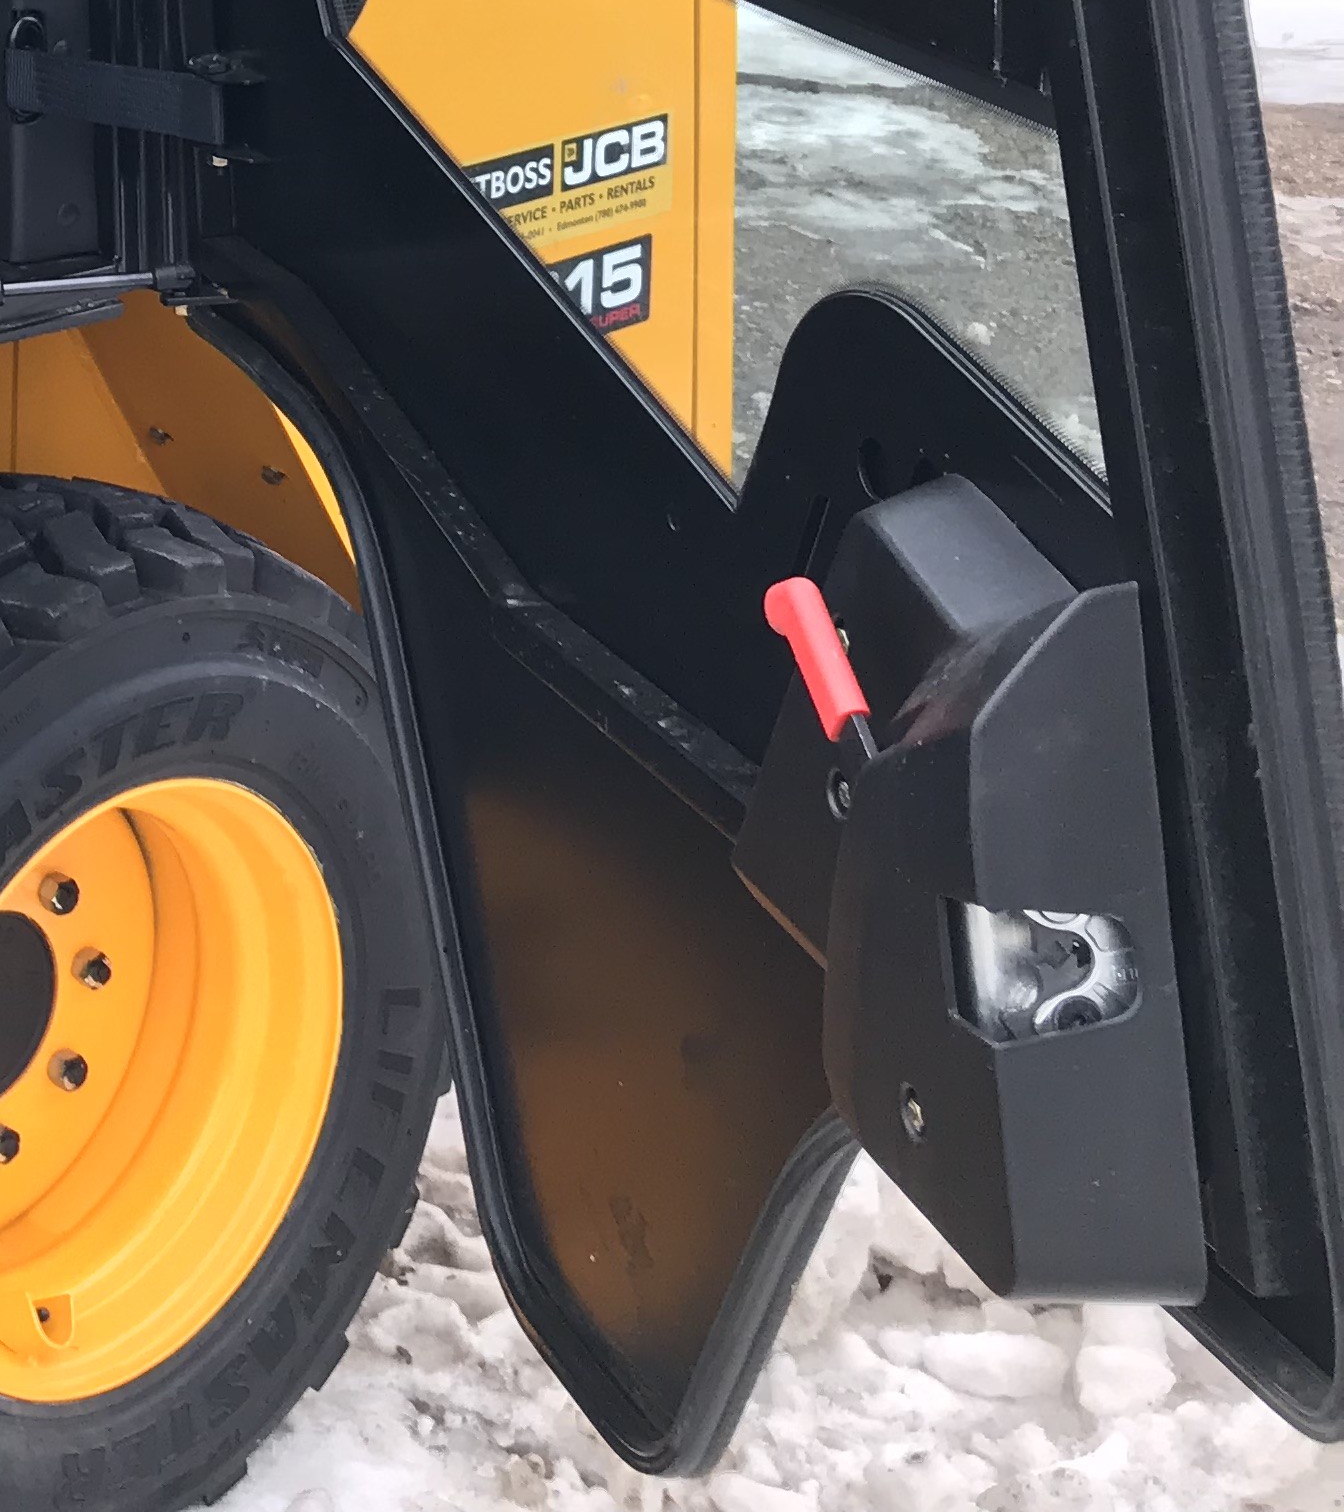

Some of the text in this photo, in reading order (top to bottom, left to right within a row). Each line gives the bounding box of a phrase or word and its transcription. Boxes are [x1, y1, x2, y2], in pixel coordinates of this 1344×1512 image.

[474, 120, 665, 200] TBOSS JCB
[507, 175, 656, 228] ERVICE PARTS RENTALS
[549, 243, 642, 316] 15
